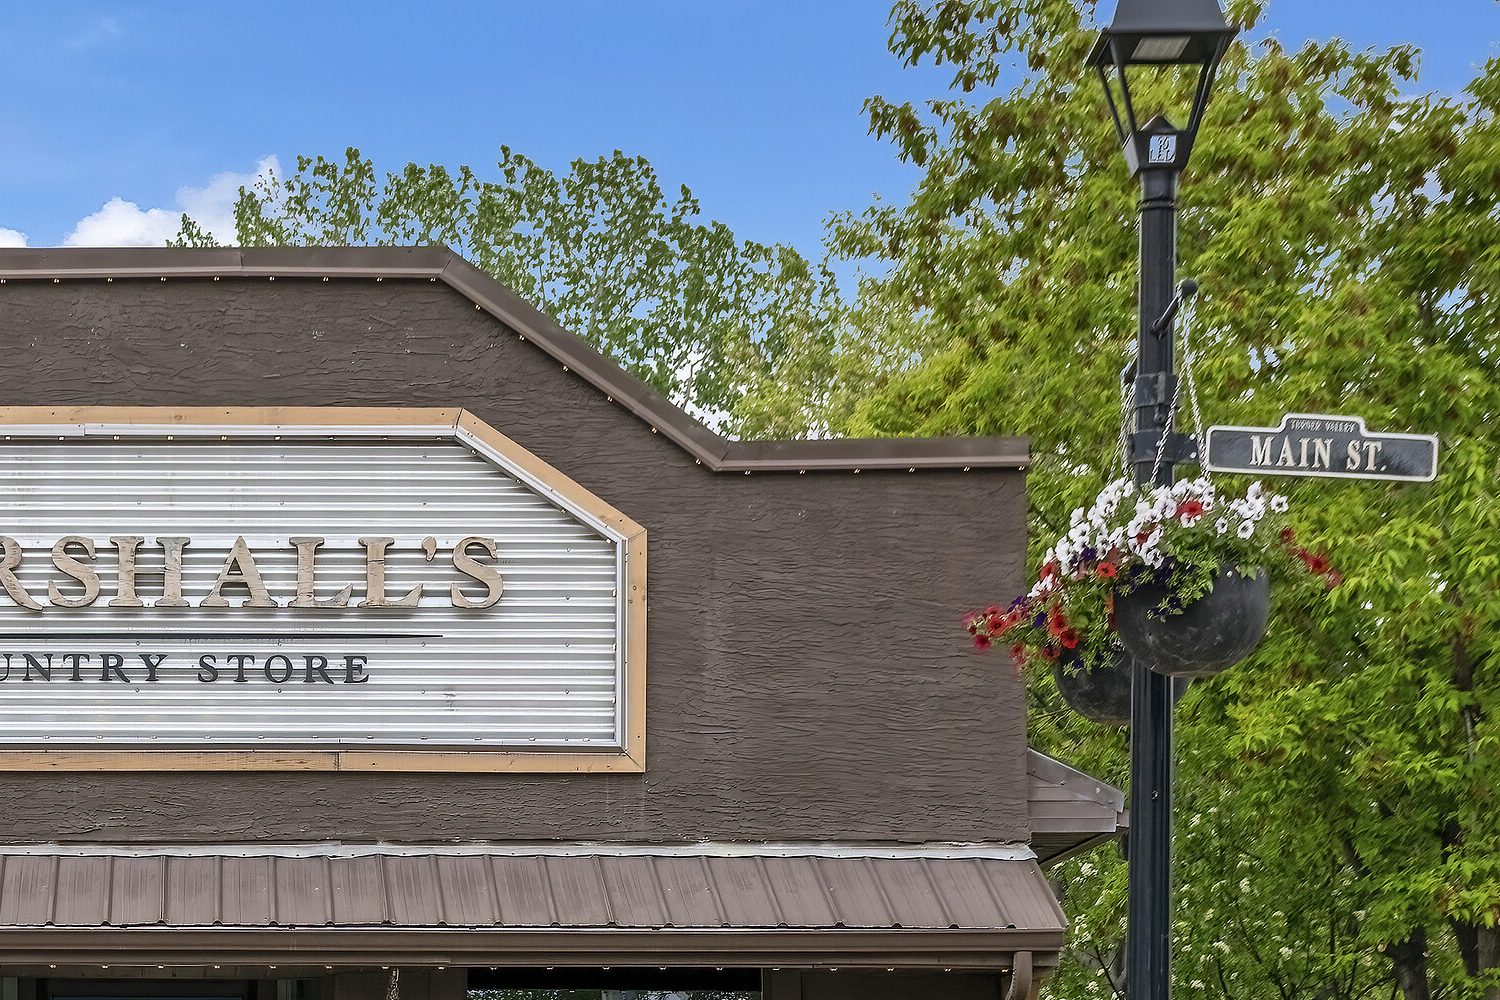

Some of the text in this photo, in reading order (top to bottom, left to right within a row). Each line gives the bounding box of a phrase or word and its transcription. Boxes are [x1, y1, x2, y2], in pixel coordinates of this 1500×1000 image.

[1249, 435, 1387, 472] MAIN ST.
[197, 654, 370, 685] STORE
